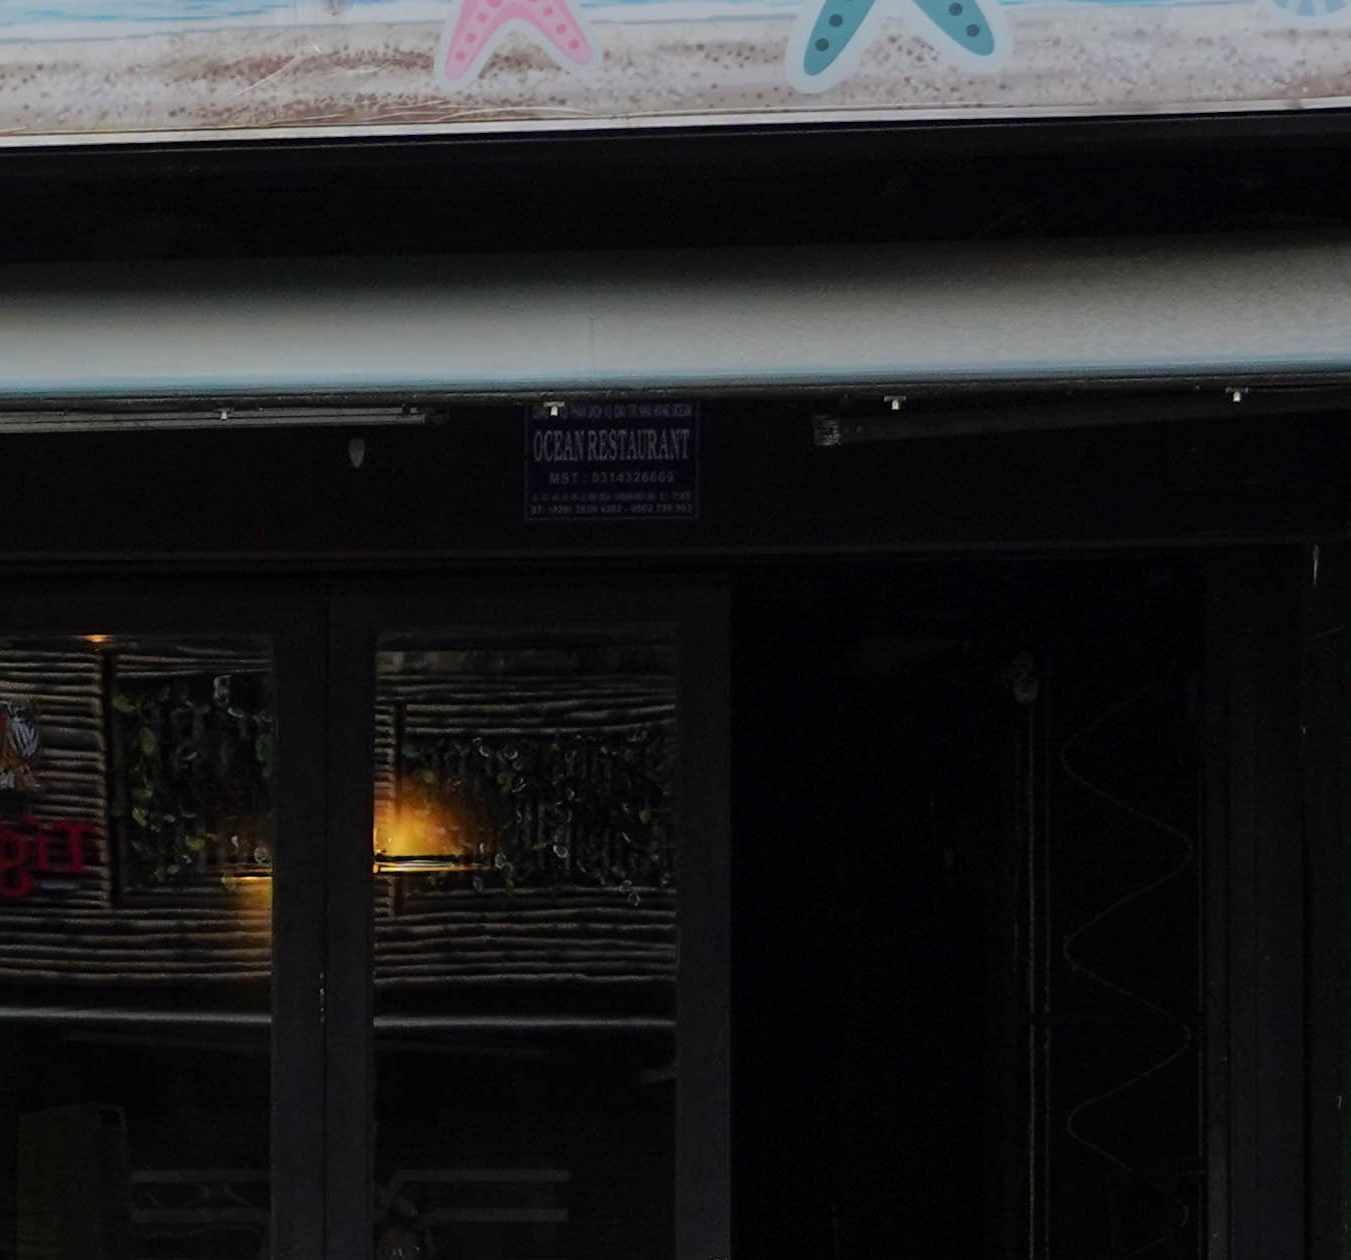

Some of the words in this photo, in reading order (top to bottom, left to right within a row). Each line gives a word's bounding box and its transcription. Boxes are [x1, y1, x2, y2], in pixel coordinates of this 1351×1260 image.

[533, 429, 585, 461] OCEAN
[588, 429, 690, 461] RESTAURANT
[549, 472, 578, 485] MST
